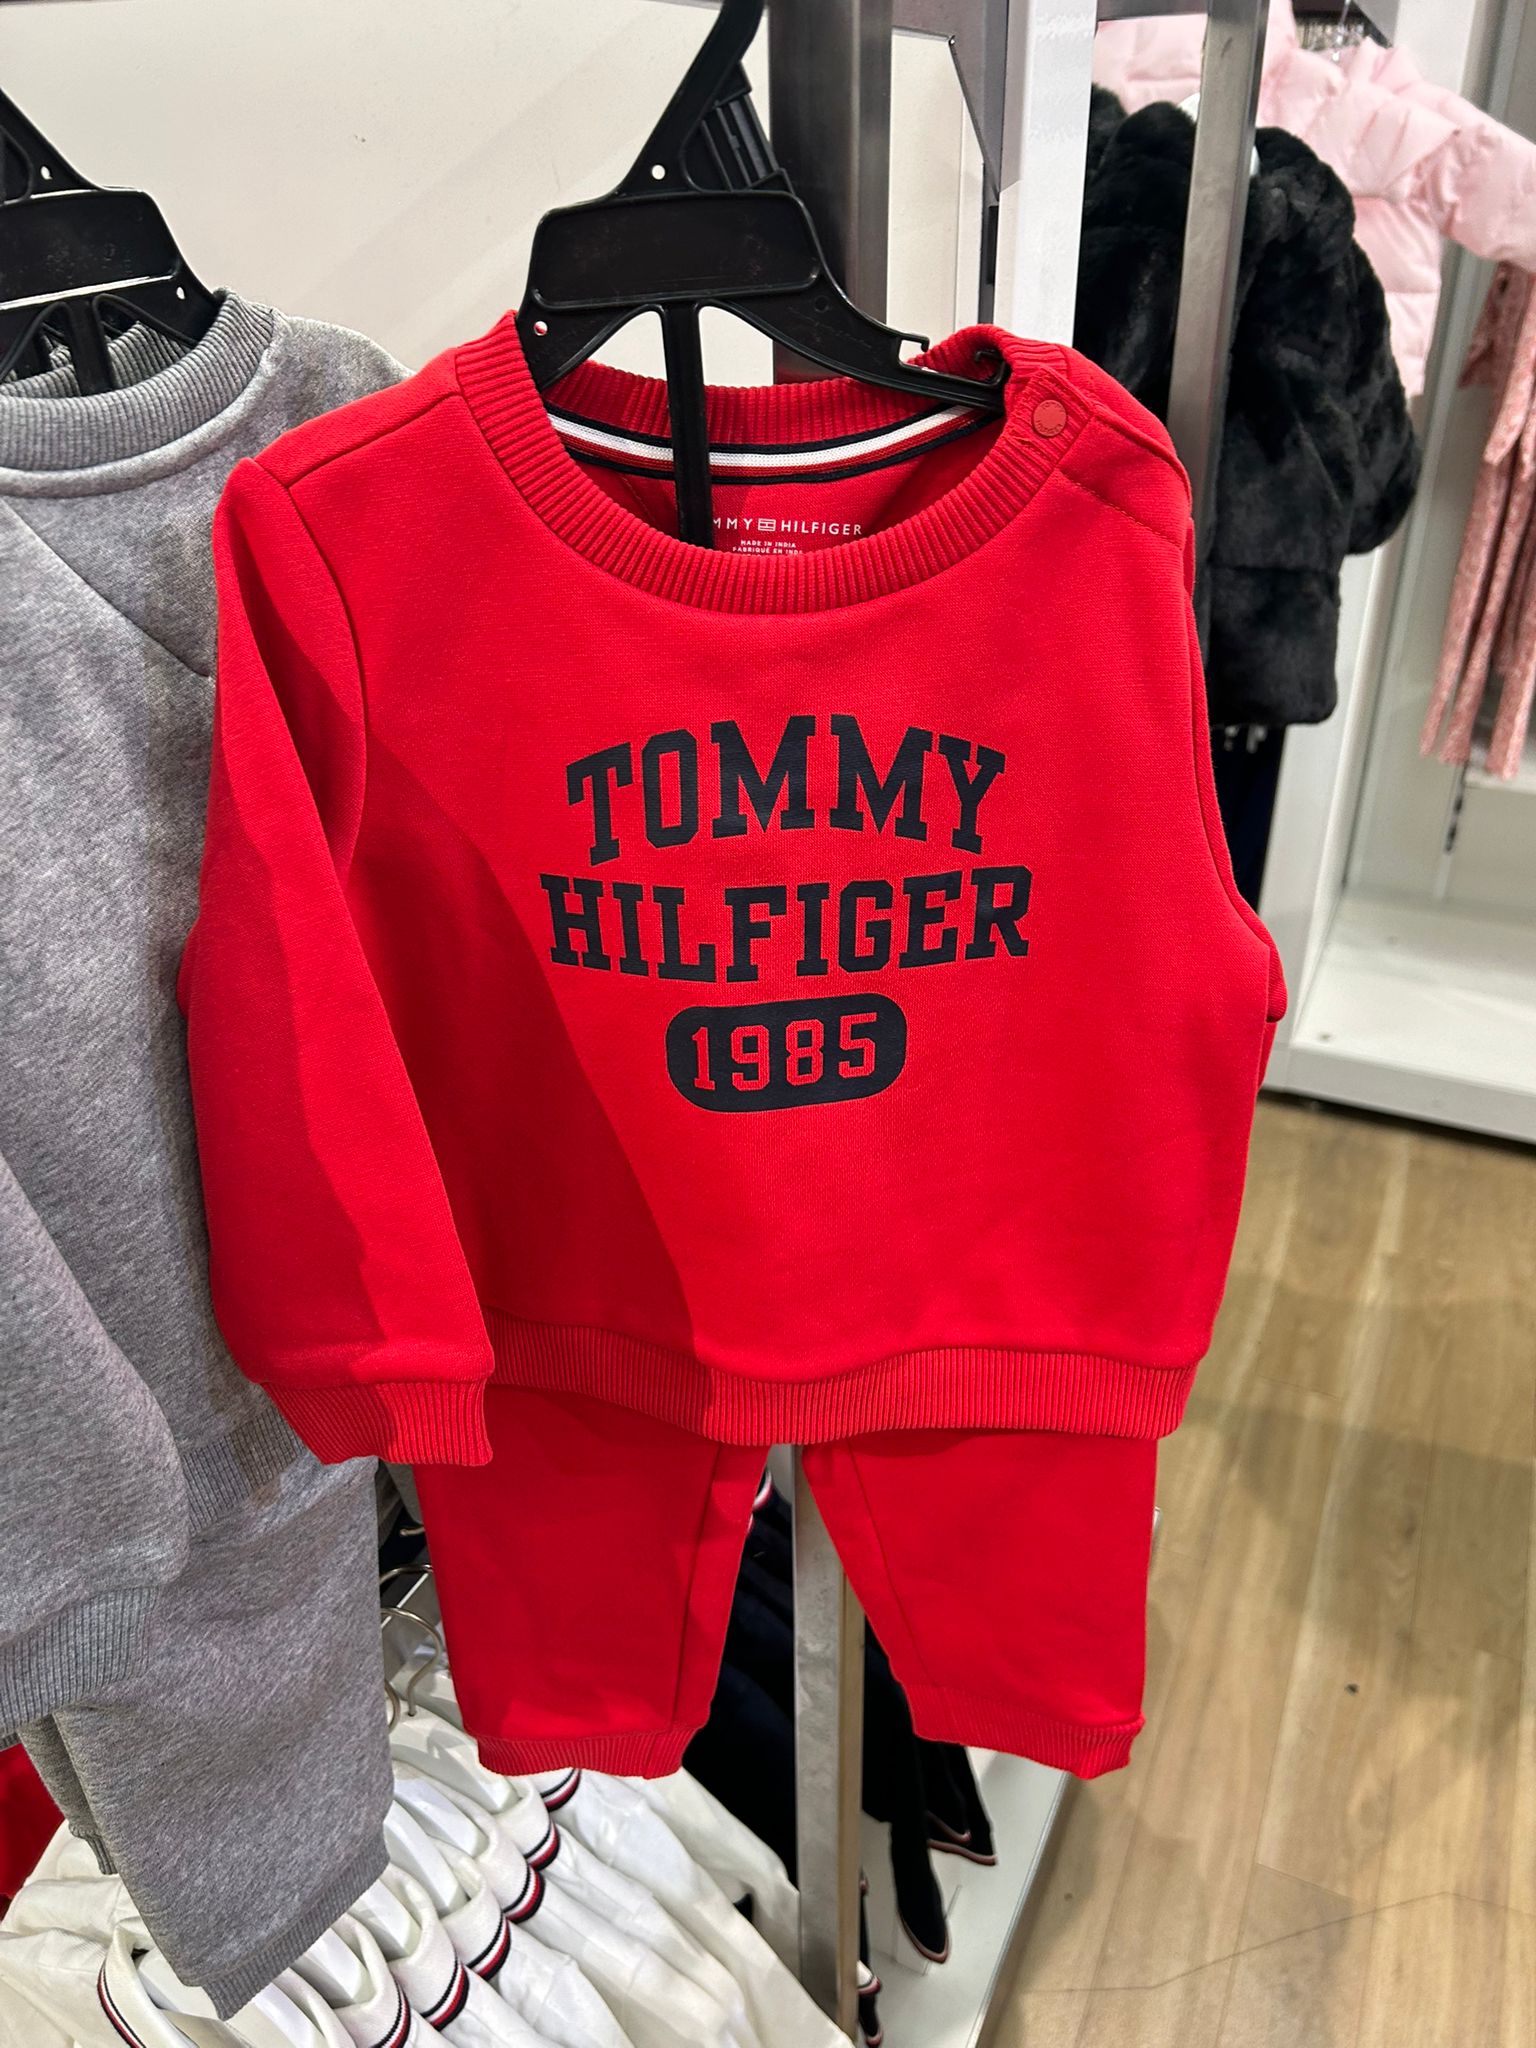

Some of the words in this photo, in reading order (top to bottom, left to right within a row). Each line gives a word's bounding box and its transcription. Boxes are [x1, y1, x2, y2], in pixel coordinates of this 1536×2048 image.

[713, 517, 753, 530] MMY
[781, 519, 862, 535] HILFIGER
[732, 546, 770, 554] FABRIQUE
[740, 539, 762, 547] MADE
[775, 541, 796, 549] INDIA
[567, 715, 1005, 866] TOMMY
[540, 866, 1032, 982] HILFIGER
[692, 1013, 877, 1091] 1985
